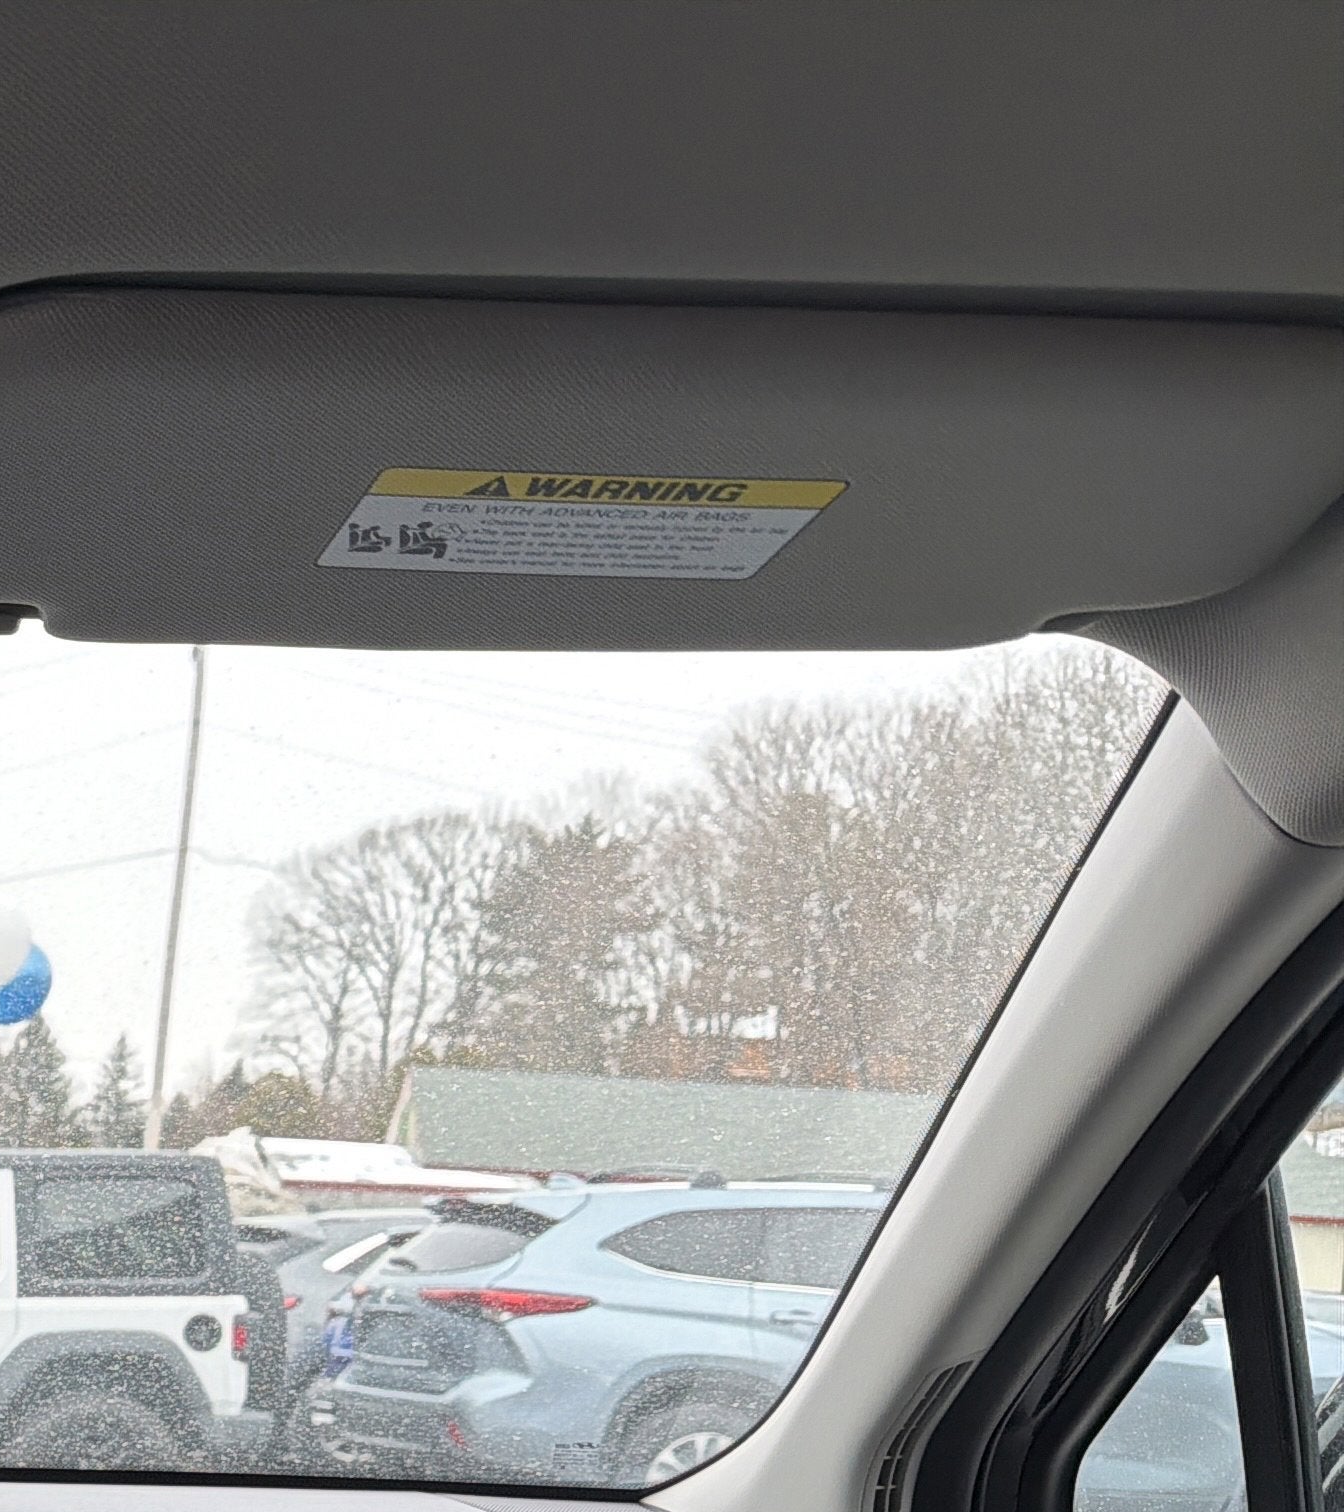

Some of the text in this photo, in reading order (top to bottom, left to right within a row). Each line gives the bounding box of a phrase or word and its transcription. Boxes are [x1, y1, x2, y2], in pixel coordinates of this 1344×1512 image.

[525, 477, 748, 502] WARNING
[421, 502, 752, 521] EVEN WITH ADVANCED AIR BAGS
